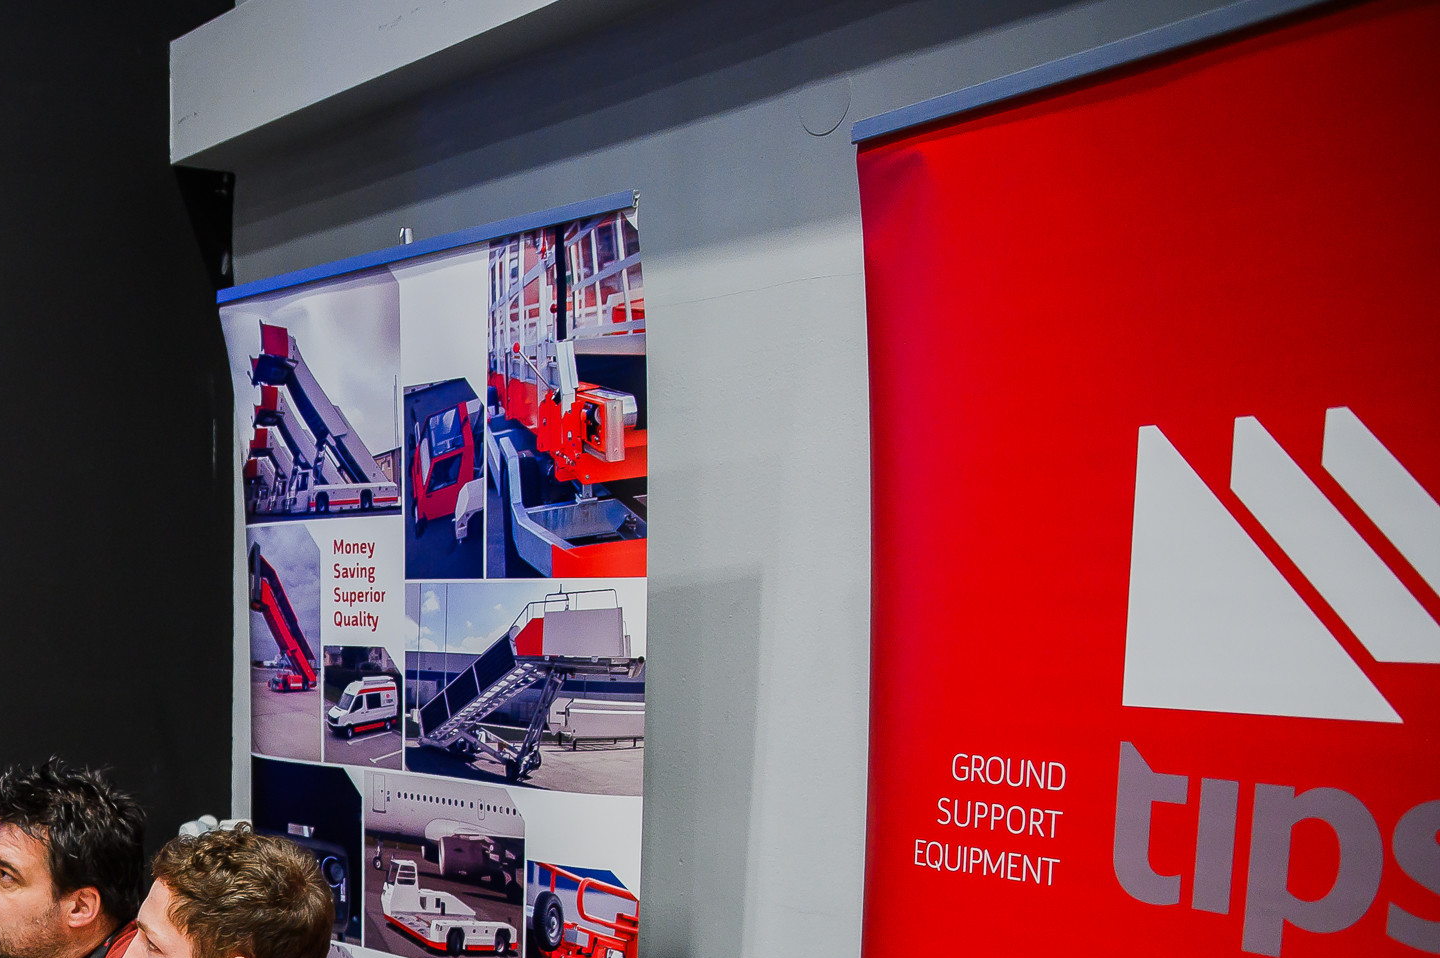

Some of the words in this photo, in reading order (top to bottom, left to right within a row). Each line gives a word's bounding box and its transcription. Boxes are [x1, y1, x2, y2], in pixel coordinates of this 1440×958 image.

[333, 539, 375, 559] Money
[333, 562, 375, 583] Saving
[333, 586, 386, 607] Superior
[333, 610, 379, 632] Quality
[951, 753, 1067, 792] GROUND
[936, 798, 1064, 840] SUPPORT
[913, 839, 1061, 887] EQUIPMENT
